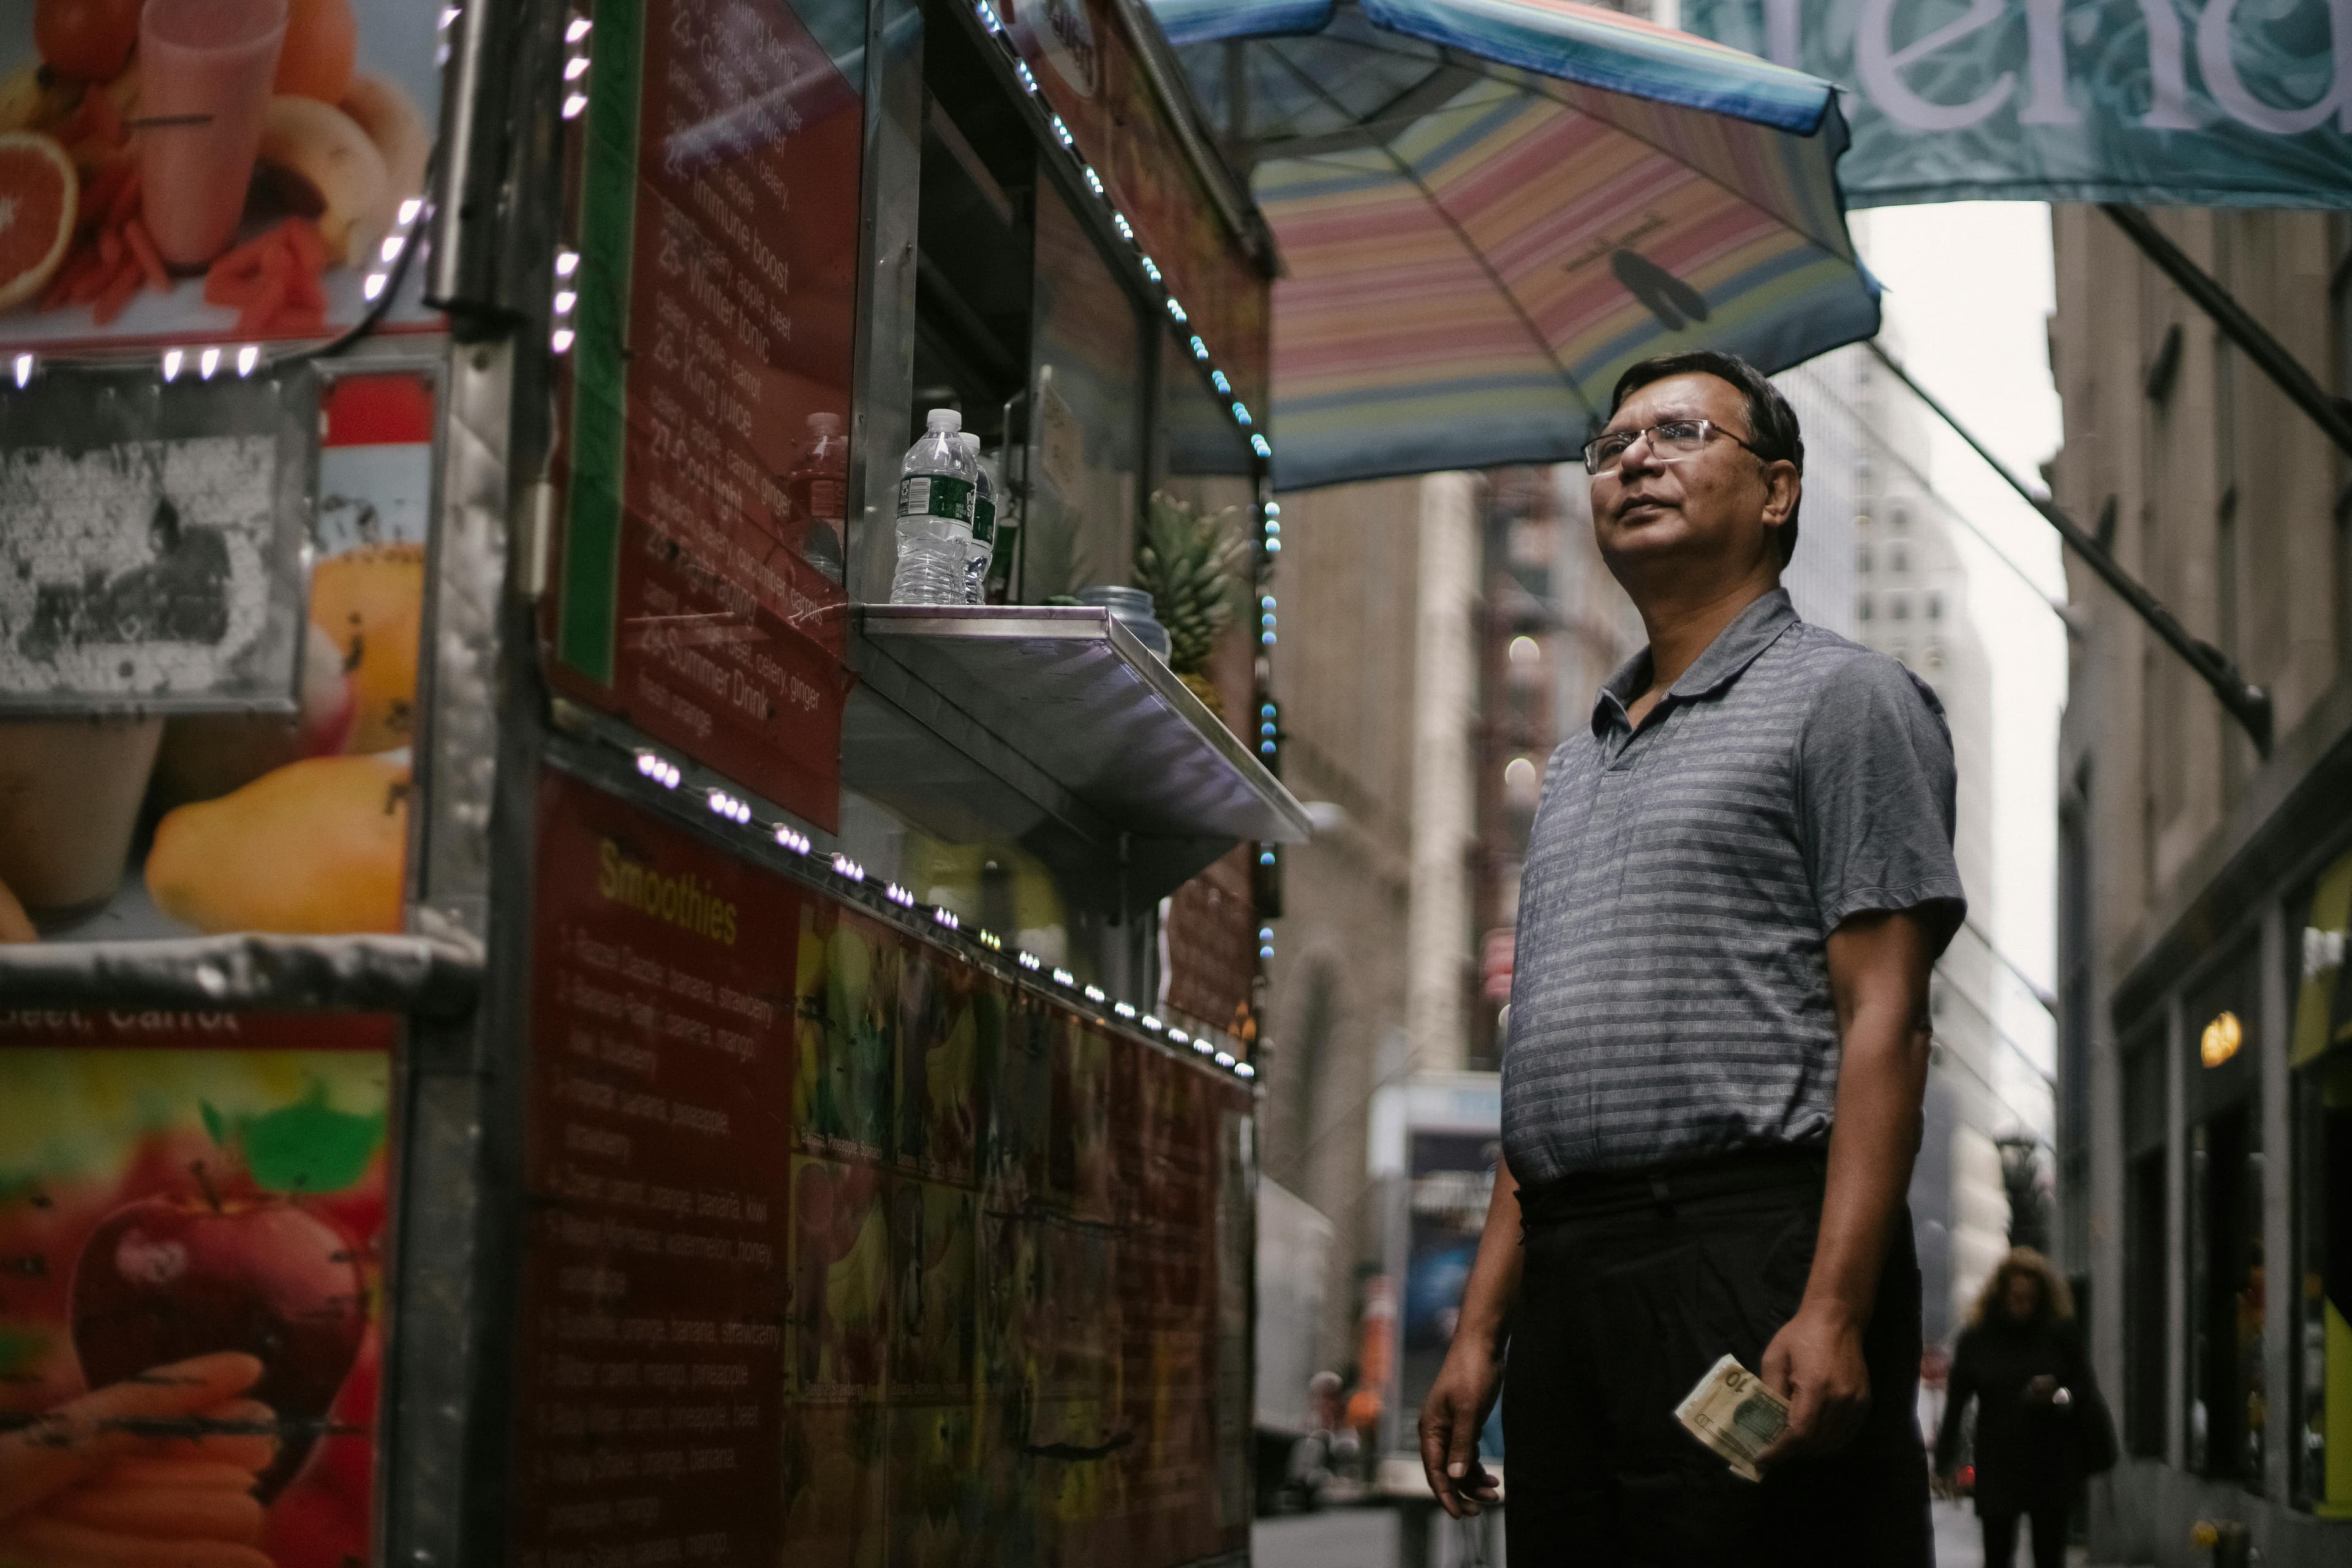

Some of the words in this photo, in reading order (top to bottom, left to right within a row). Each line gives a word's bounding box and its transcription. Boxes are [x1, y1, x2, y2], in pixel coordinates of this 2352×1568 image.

[767, 23, 797, 87] tonic
[700, 33, 742, 110] Green
[747, 94, 787, 157] power
[772, 87, 802, 134] ginger
[726, 167, 754, 213] apple
[693, 163, 750, 252] Immune
[753, 225, 789, 295] boost
[688, 254, 736, 330] Winter
[738, 306, 770, 364] tonic
[771, 297, 791, 342] beet
[684, 345, 717, 417] King
[718, 379, 752, 439] juice
[731, 359, 762, 402] carrot
[761, 477, 793, 518] ginger
[733, 668, 769, 721] Drink
[756, 652, 788, 697] celery,
[790, 671, 820, 712] ginger
[598, 837, 737, 945] Smoothies
